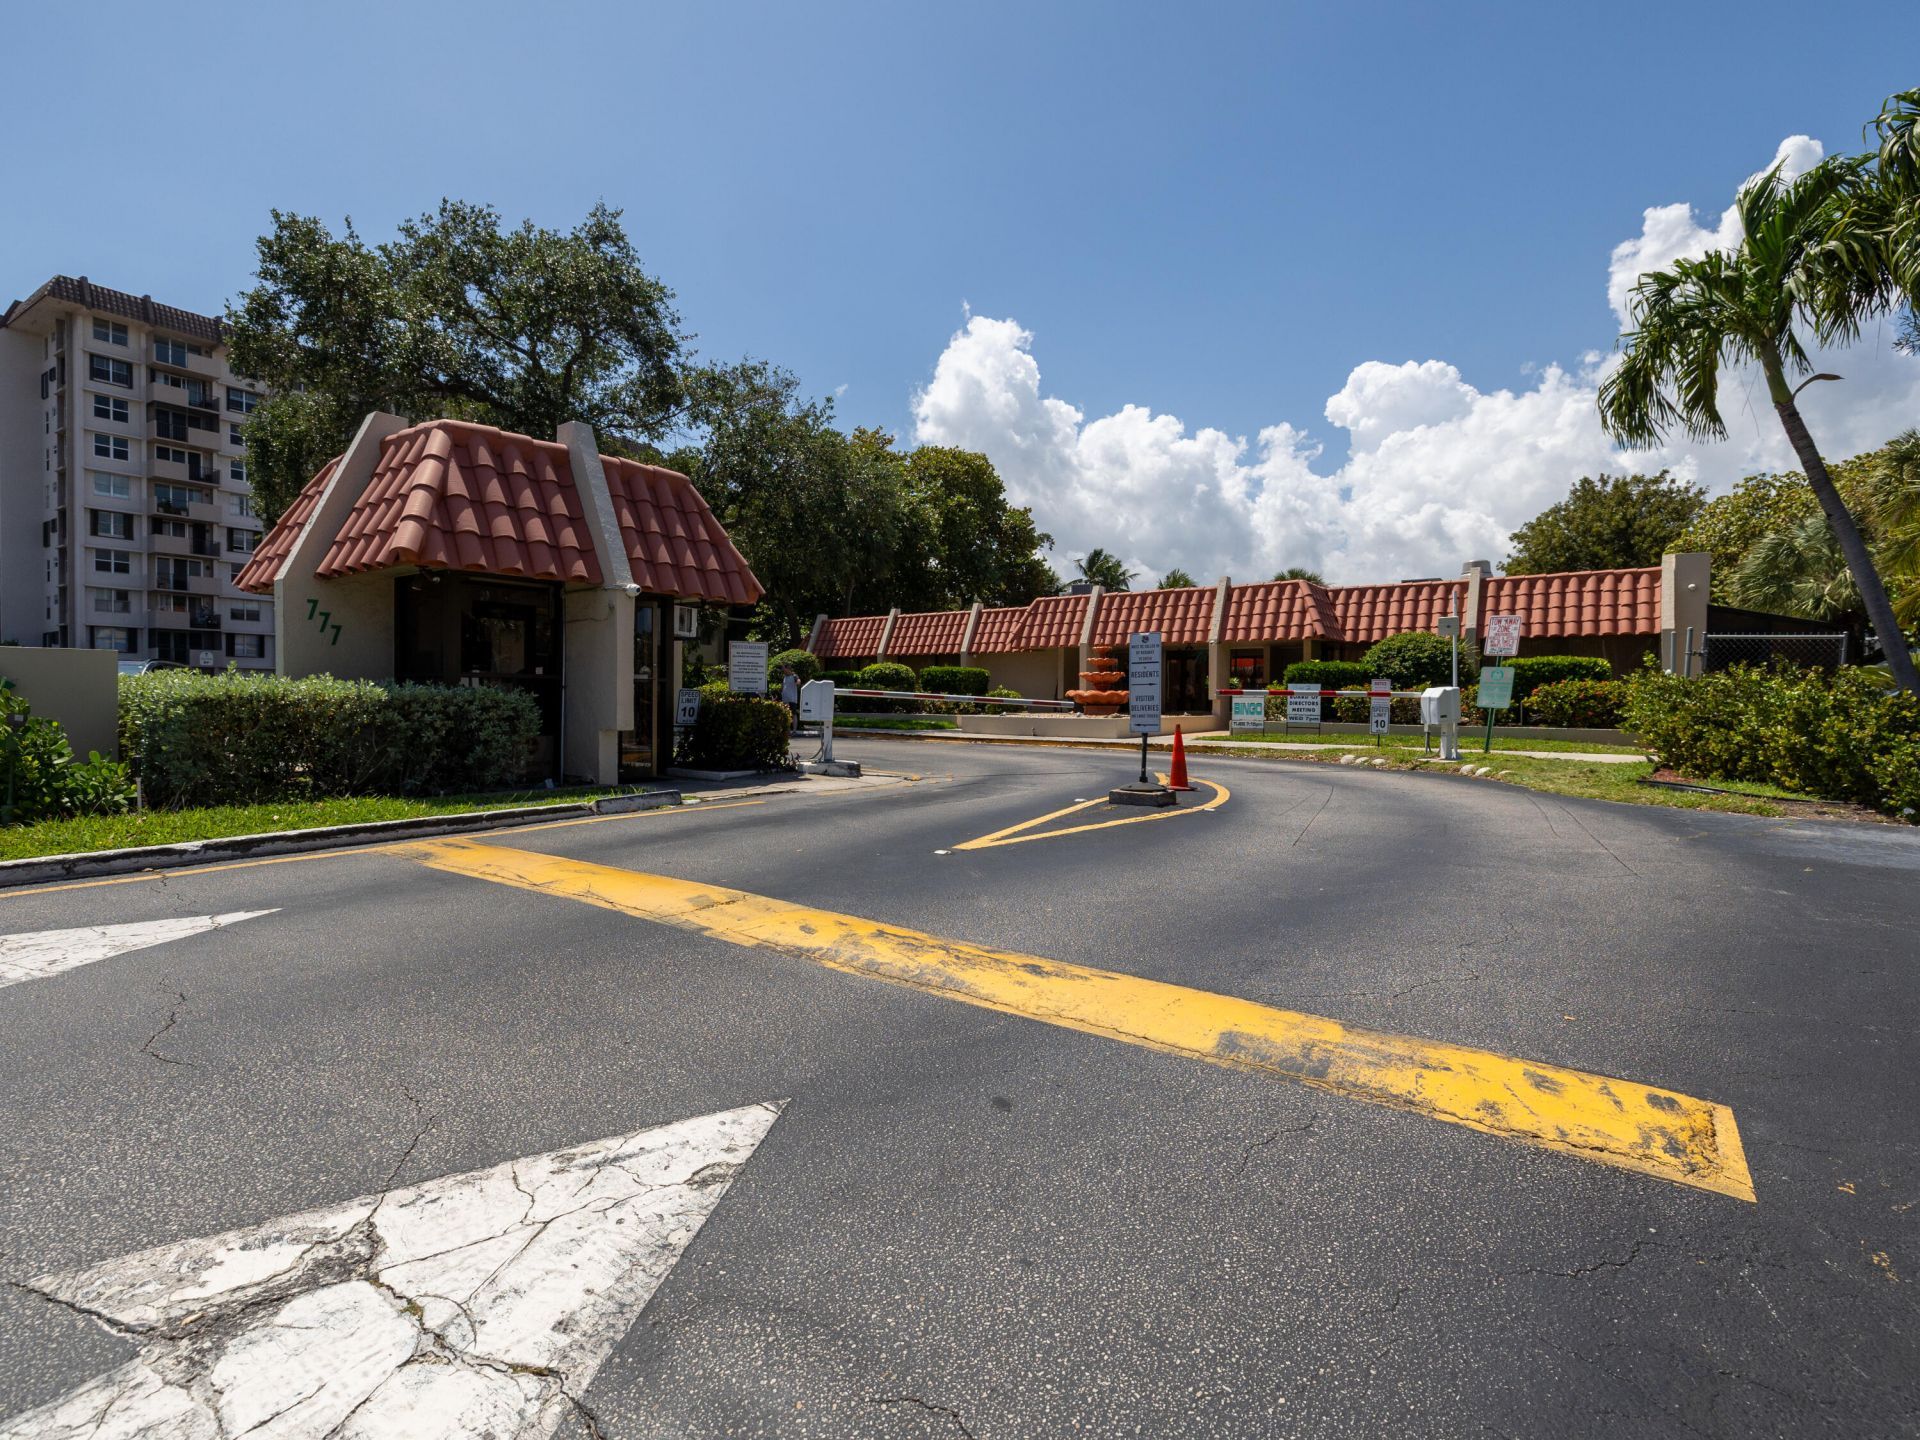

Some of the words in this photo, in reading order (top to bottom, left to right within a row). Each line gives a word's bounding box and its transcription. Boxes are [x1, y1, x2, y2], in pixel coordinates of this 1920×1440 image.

[306, 598, 343, 646] 777
[680, 690, 699, 698] SPEED
[681, 706, 695, 718] 10
[1233, 702, 1263, 715] BINGO
[1374, 719, 1386, 728] 10
